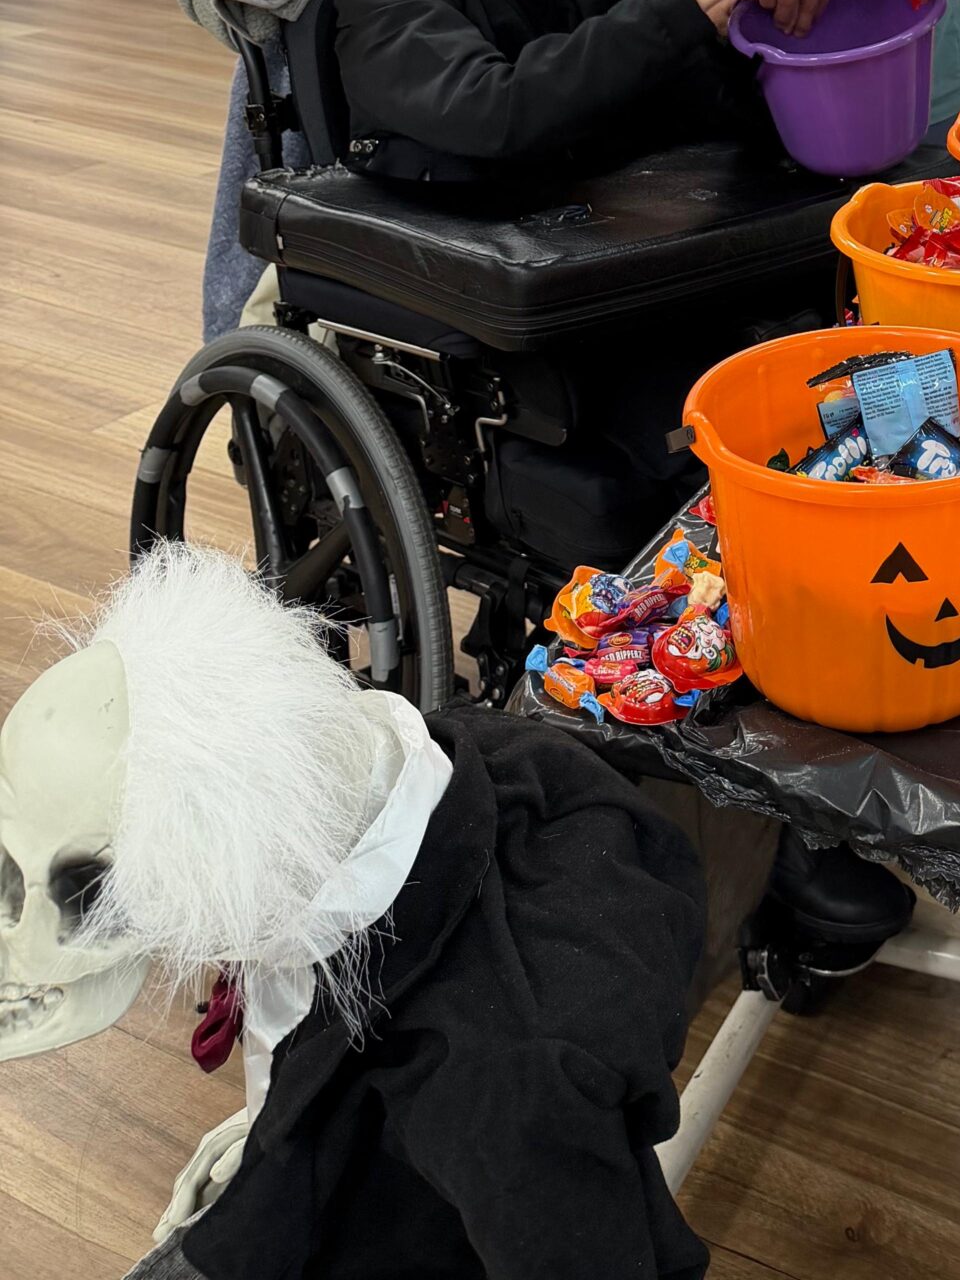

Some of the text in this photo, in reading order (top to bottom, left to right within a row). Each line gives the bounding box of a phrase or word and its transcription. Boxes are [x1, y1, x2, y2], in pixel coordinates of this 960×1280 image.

[634, 593, 665, 618] RED RIPPERZ
[615, 649, 643, 662] RIPPERZ
